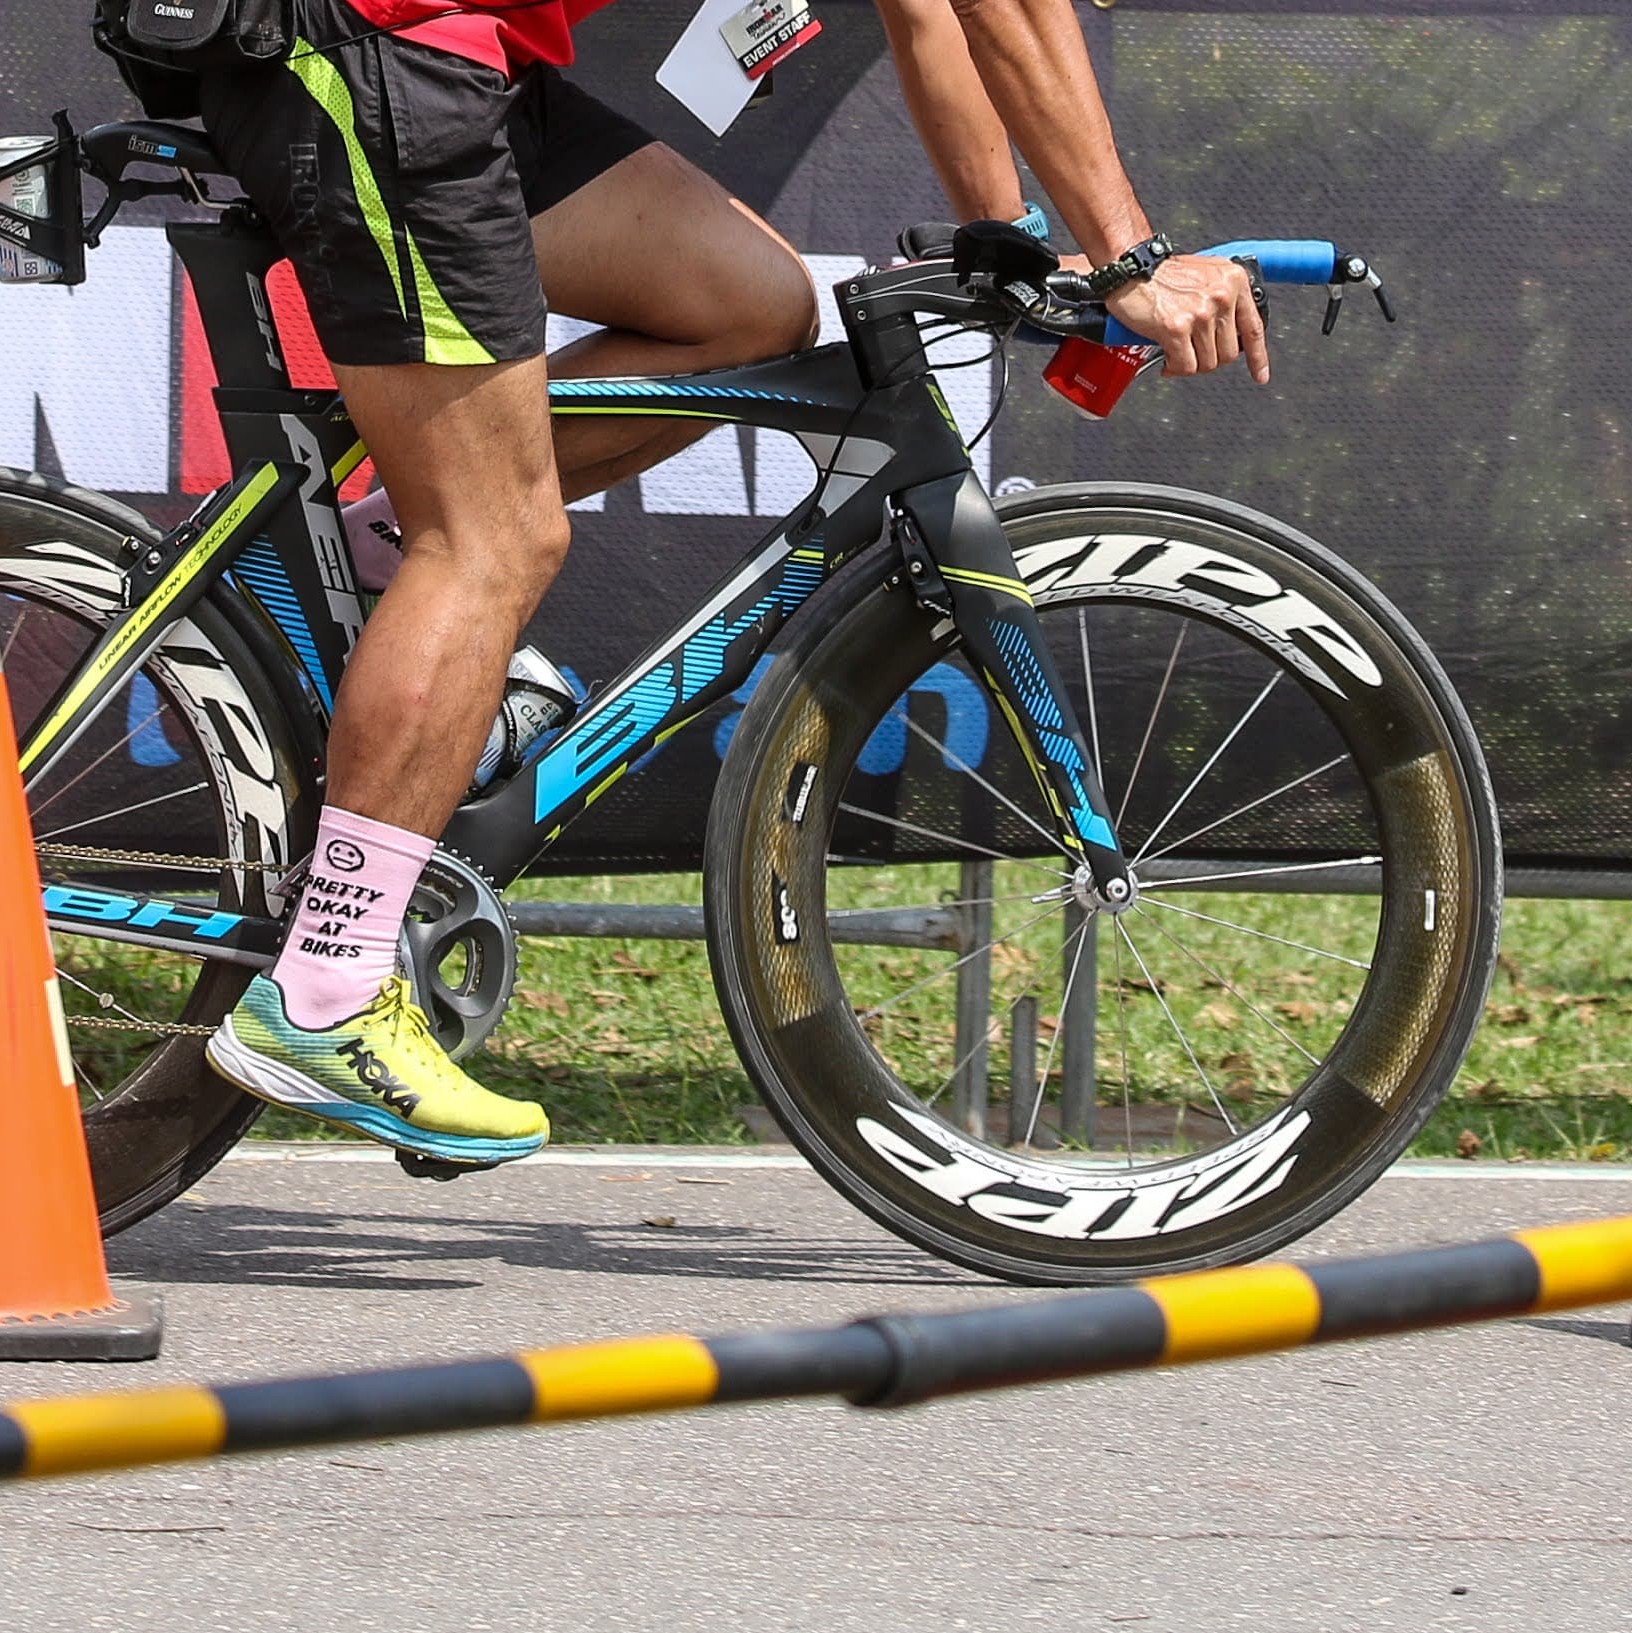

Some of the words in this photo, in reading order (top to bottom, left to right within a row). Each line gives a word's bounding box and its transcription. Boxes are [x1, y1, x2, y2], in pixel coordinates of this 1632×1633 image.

[154, 3, 195, 20] GUINNESS
[743, 36, 779, 69] EVENT
[778, 10, 811, 41] STAFF
[246, 271, 282, 371] BH
[98, 624, 137, 671] LINEAR
[138, 572, 183, 626] AIRFLOW
[182, 502, 245, 575] TECHNOLOGY
[41, 884, 244, 939] BH
[306, 896, 369, 920] OKAY
[307, 873, 385, 903] PRETTY
[300, 938, 363, 959] BIKES
[318, 921, 347, 937] AT
[336, 1037, 422, 1120] HOKA
[856, 1109, 1312, 1241] ZIPP
